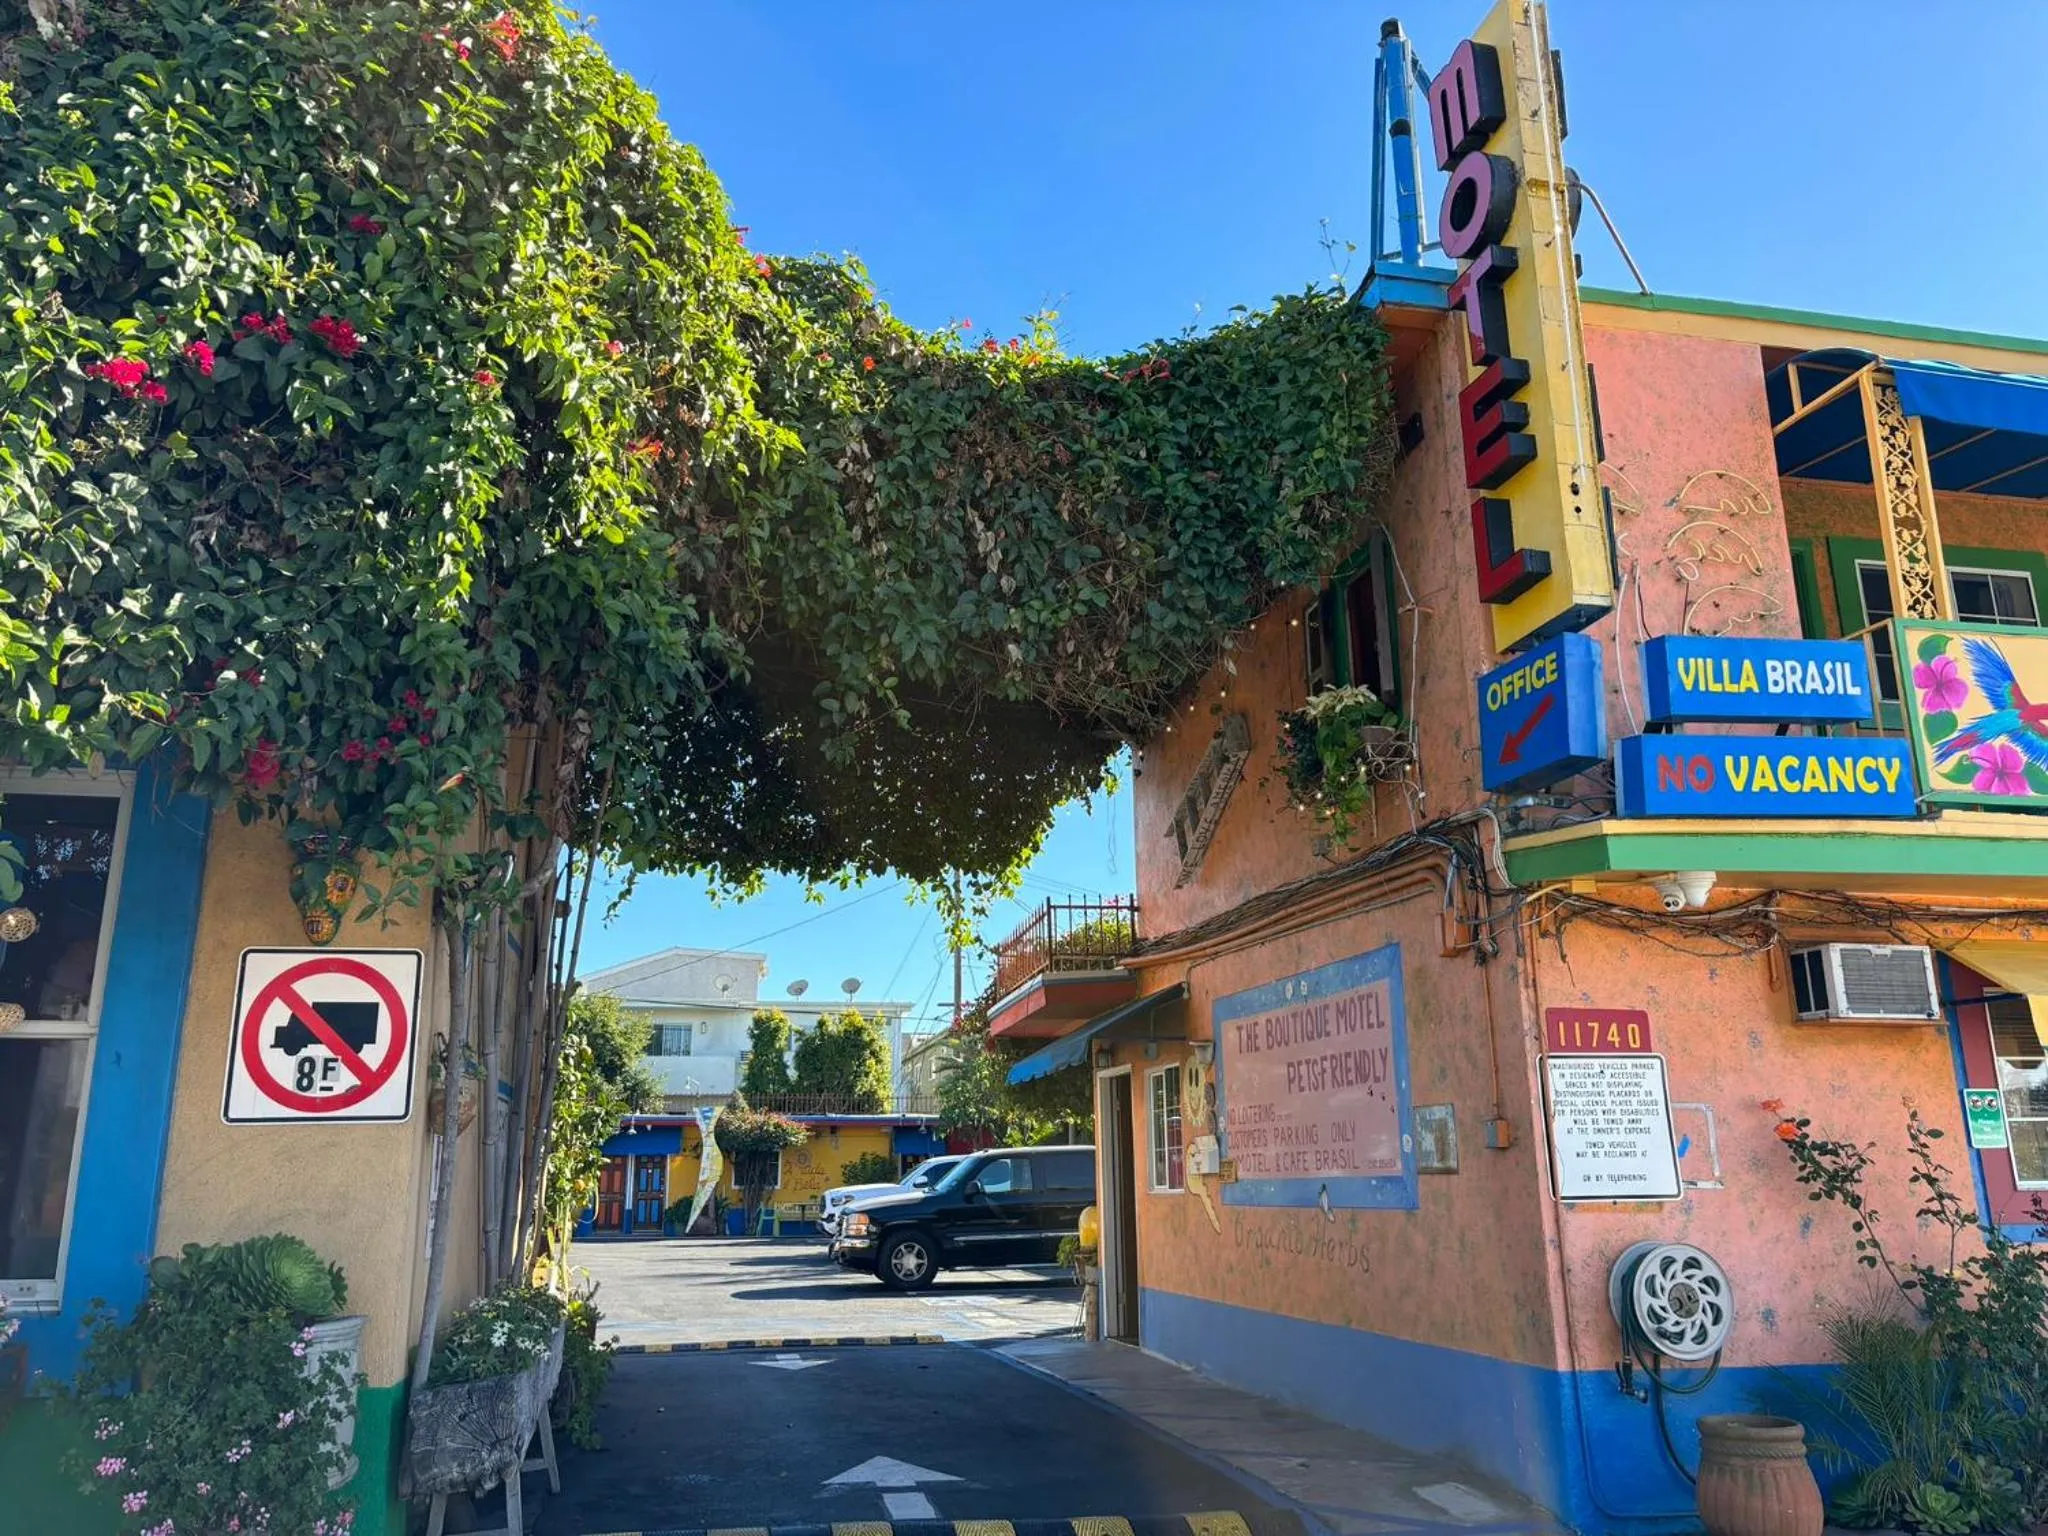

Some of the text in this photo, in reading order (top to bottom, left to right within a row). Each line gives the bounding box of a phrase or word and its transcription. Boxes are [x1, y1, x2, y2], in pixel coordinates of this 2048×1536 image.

[1429, 39, 1550, 604] MOTEL
[1487, 651, 1558, 711] OFFICE
[1677, 657, 1862, 695] VILLA BRASIL
[1657, 754, 1900, 793] NO VACANCY
[1236, 991, 1385, 1054] THE BOUTIQUE MOTEL
[1558, 1021, 1640, 1048] 11740
[1582, 1099, 1607, 1107] LICENSE
[1611, 1099, 1633, 1107] PLATES
[1637, 1099, 1659, 1107] ISSUED
[1609, 1090, 1640, 1098] PLACARDS
[1645, 1090, 1653, 1098] OR
[1237, 1103, 1276, 1125] LOITERING
[1620, 1109, 1659, 1117] DISABILITIES
[1273, 1125, 1319, 1148] PARKING
[1331, 1120, 1356, 1144] ONLY
[1593, 1127, 1620, 1135] OWNER'S
[1624, 1127, 1651, 1135] EXPENSE
[1576, 1150, 1648, 1158] MAY BE RECLAIMED AT
[1608, 1141, 1636, 1149] VEHICLES
[1316, 1148, 1360, 1171] BRASIL
[1583, 1174, 1647, 1182] OR BY TELEPHONING
[1312, 1212, 1370, 1273] Herbs
